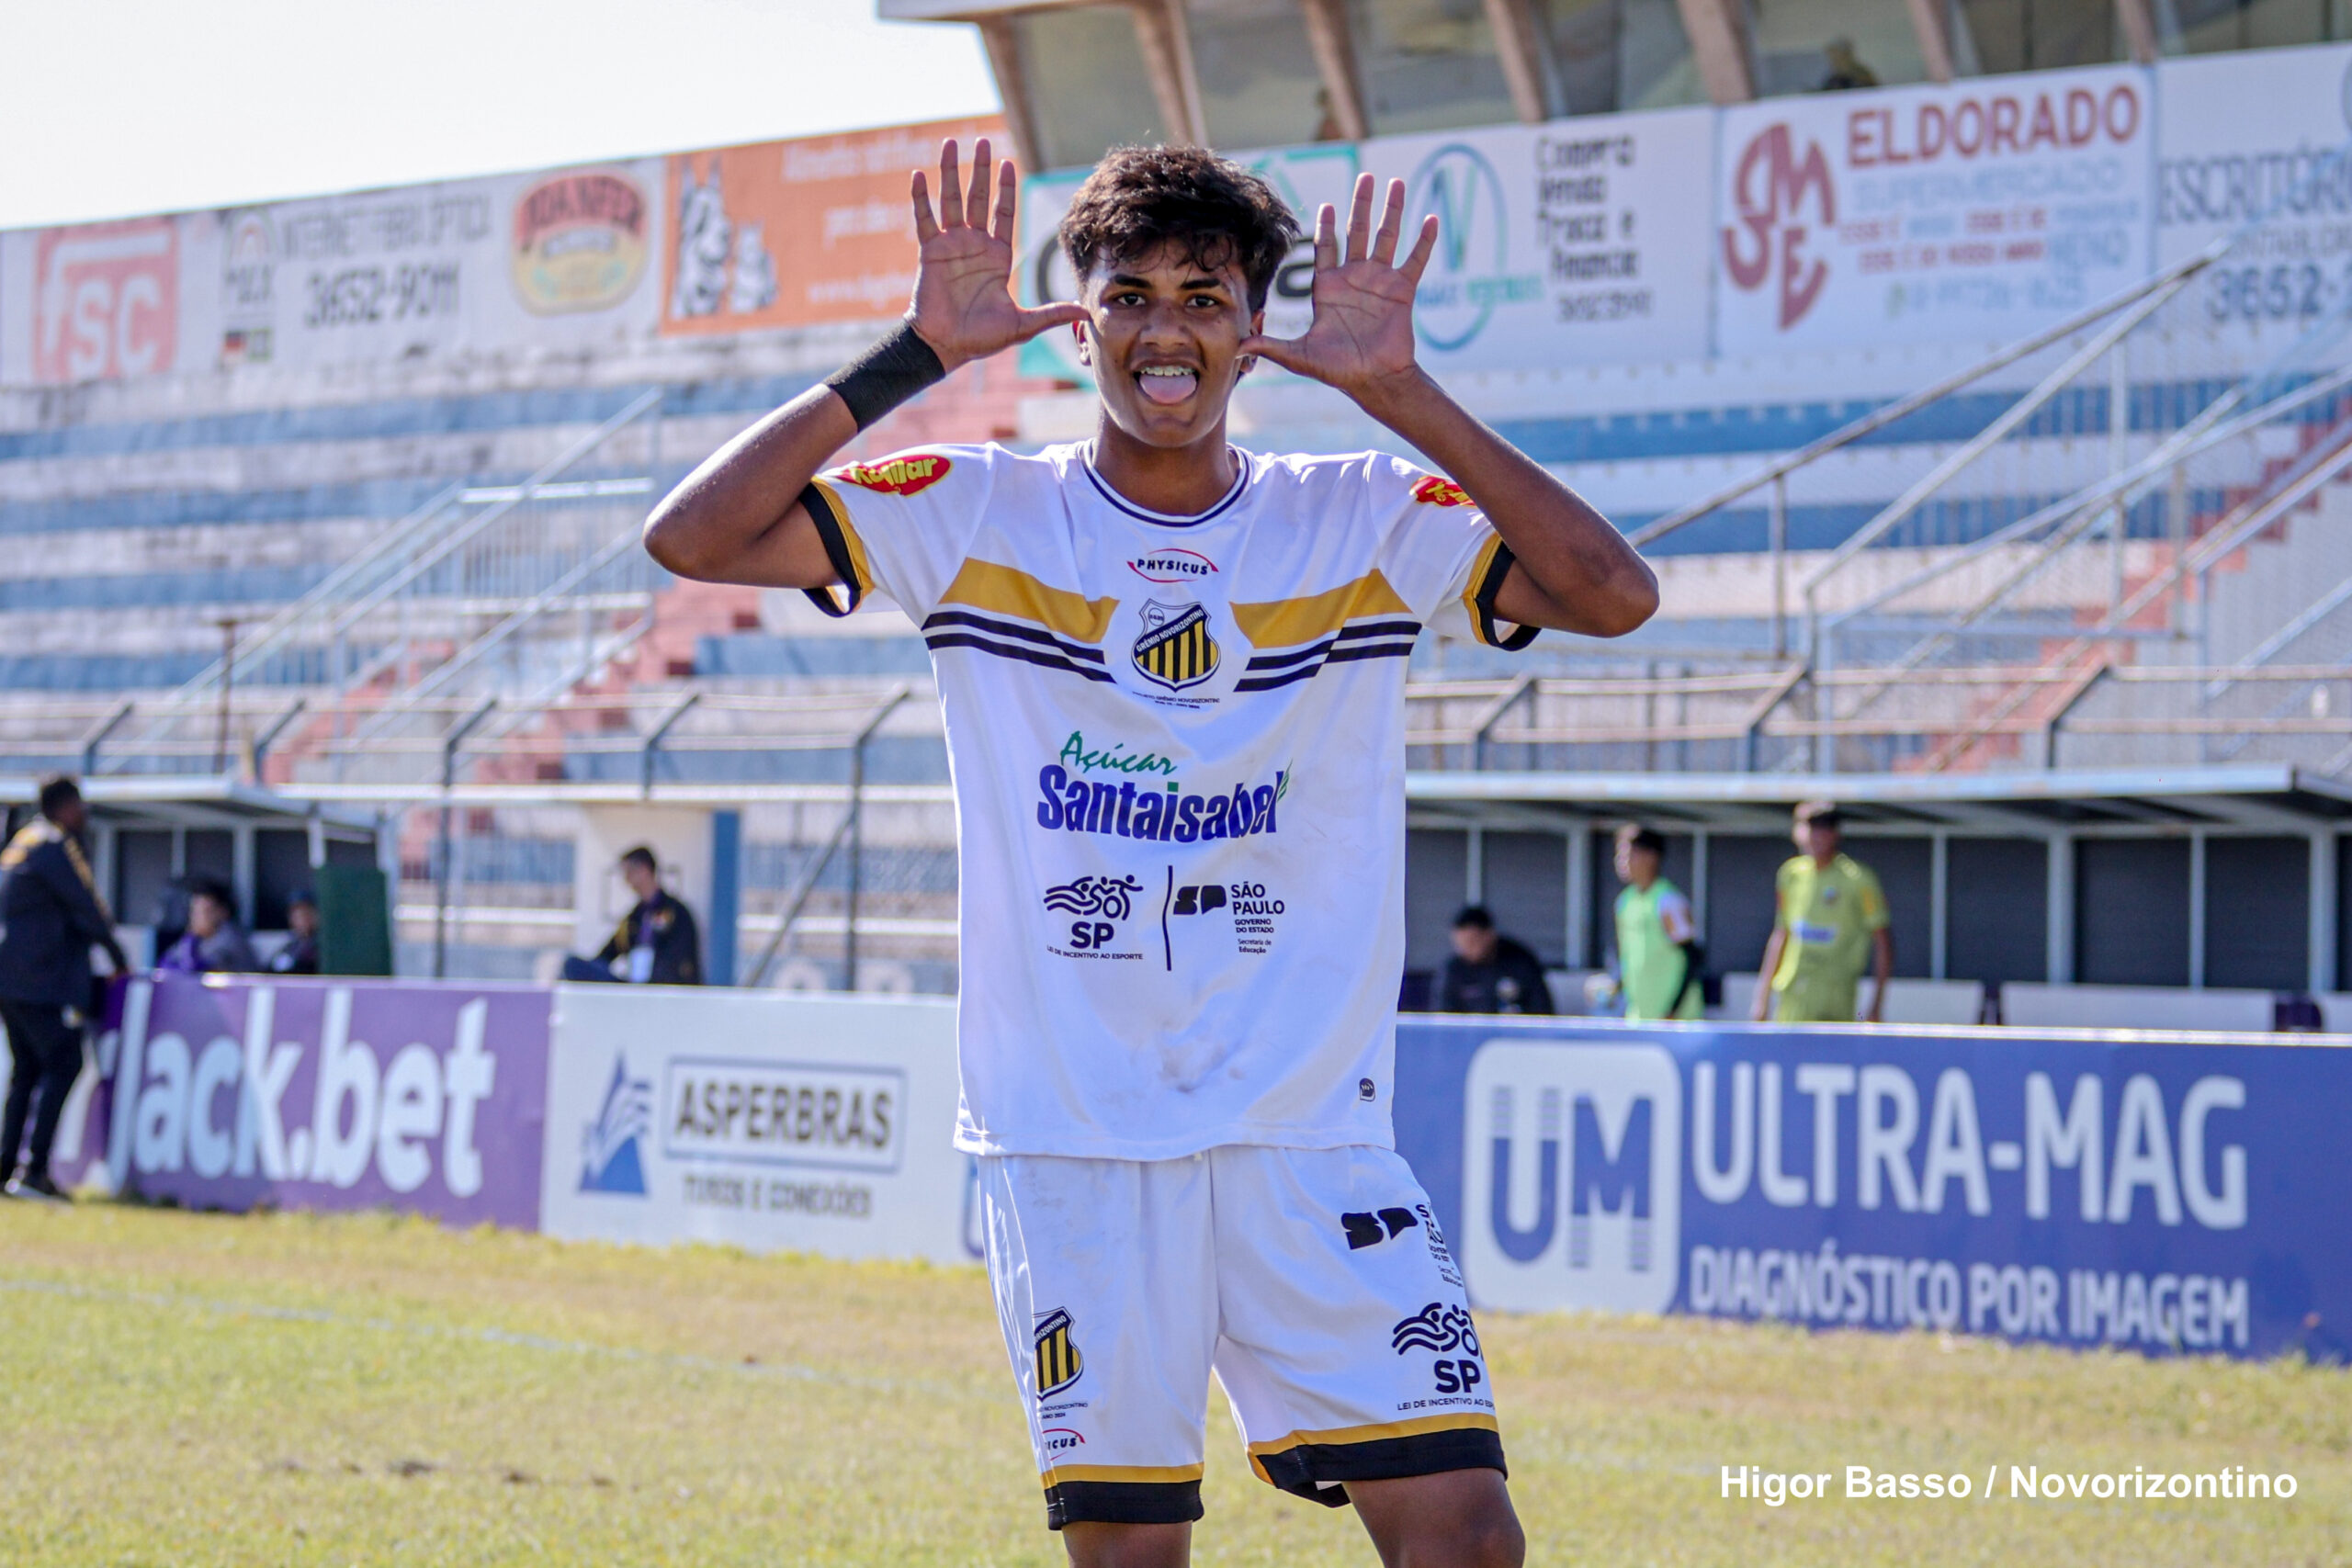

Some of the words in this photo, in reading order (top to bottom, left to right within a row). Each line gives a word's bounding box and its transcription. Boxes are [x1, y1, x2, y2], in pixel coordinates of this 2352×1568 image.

[1137, 558, 1208, 576] PHYSICUS
[1159, 608, 1204, 640] NOVORIZONTINO
[1060, 730, 1178, 776] Açúcar
[1037, 763, 1284, 843] Santaisabel
[1230, 881, 1266, 898] SÃO
[1232, 900, 1285, 915] PAULO
[1069, 921, 1114, 949] SP
[675, 1080, 891, 1148] ASPERBRAS
[1691, 1060, 2247, 1229] ULTRA-MAG
[1690, 1236, 1962, 1329] DIAGNÓSTICO
[1969, 1262, 2060, 1337] POR
[2068, 1269, 2249, 1348] IMAGEM
[1434, 1359, 1481, 1393] SP
[1397, 1402, 1411, 1411] LEI
[1414, 1400, 1426, 1408] DE
[1429, 1397, 1473, 1406] INCENTIVO
